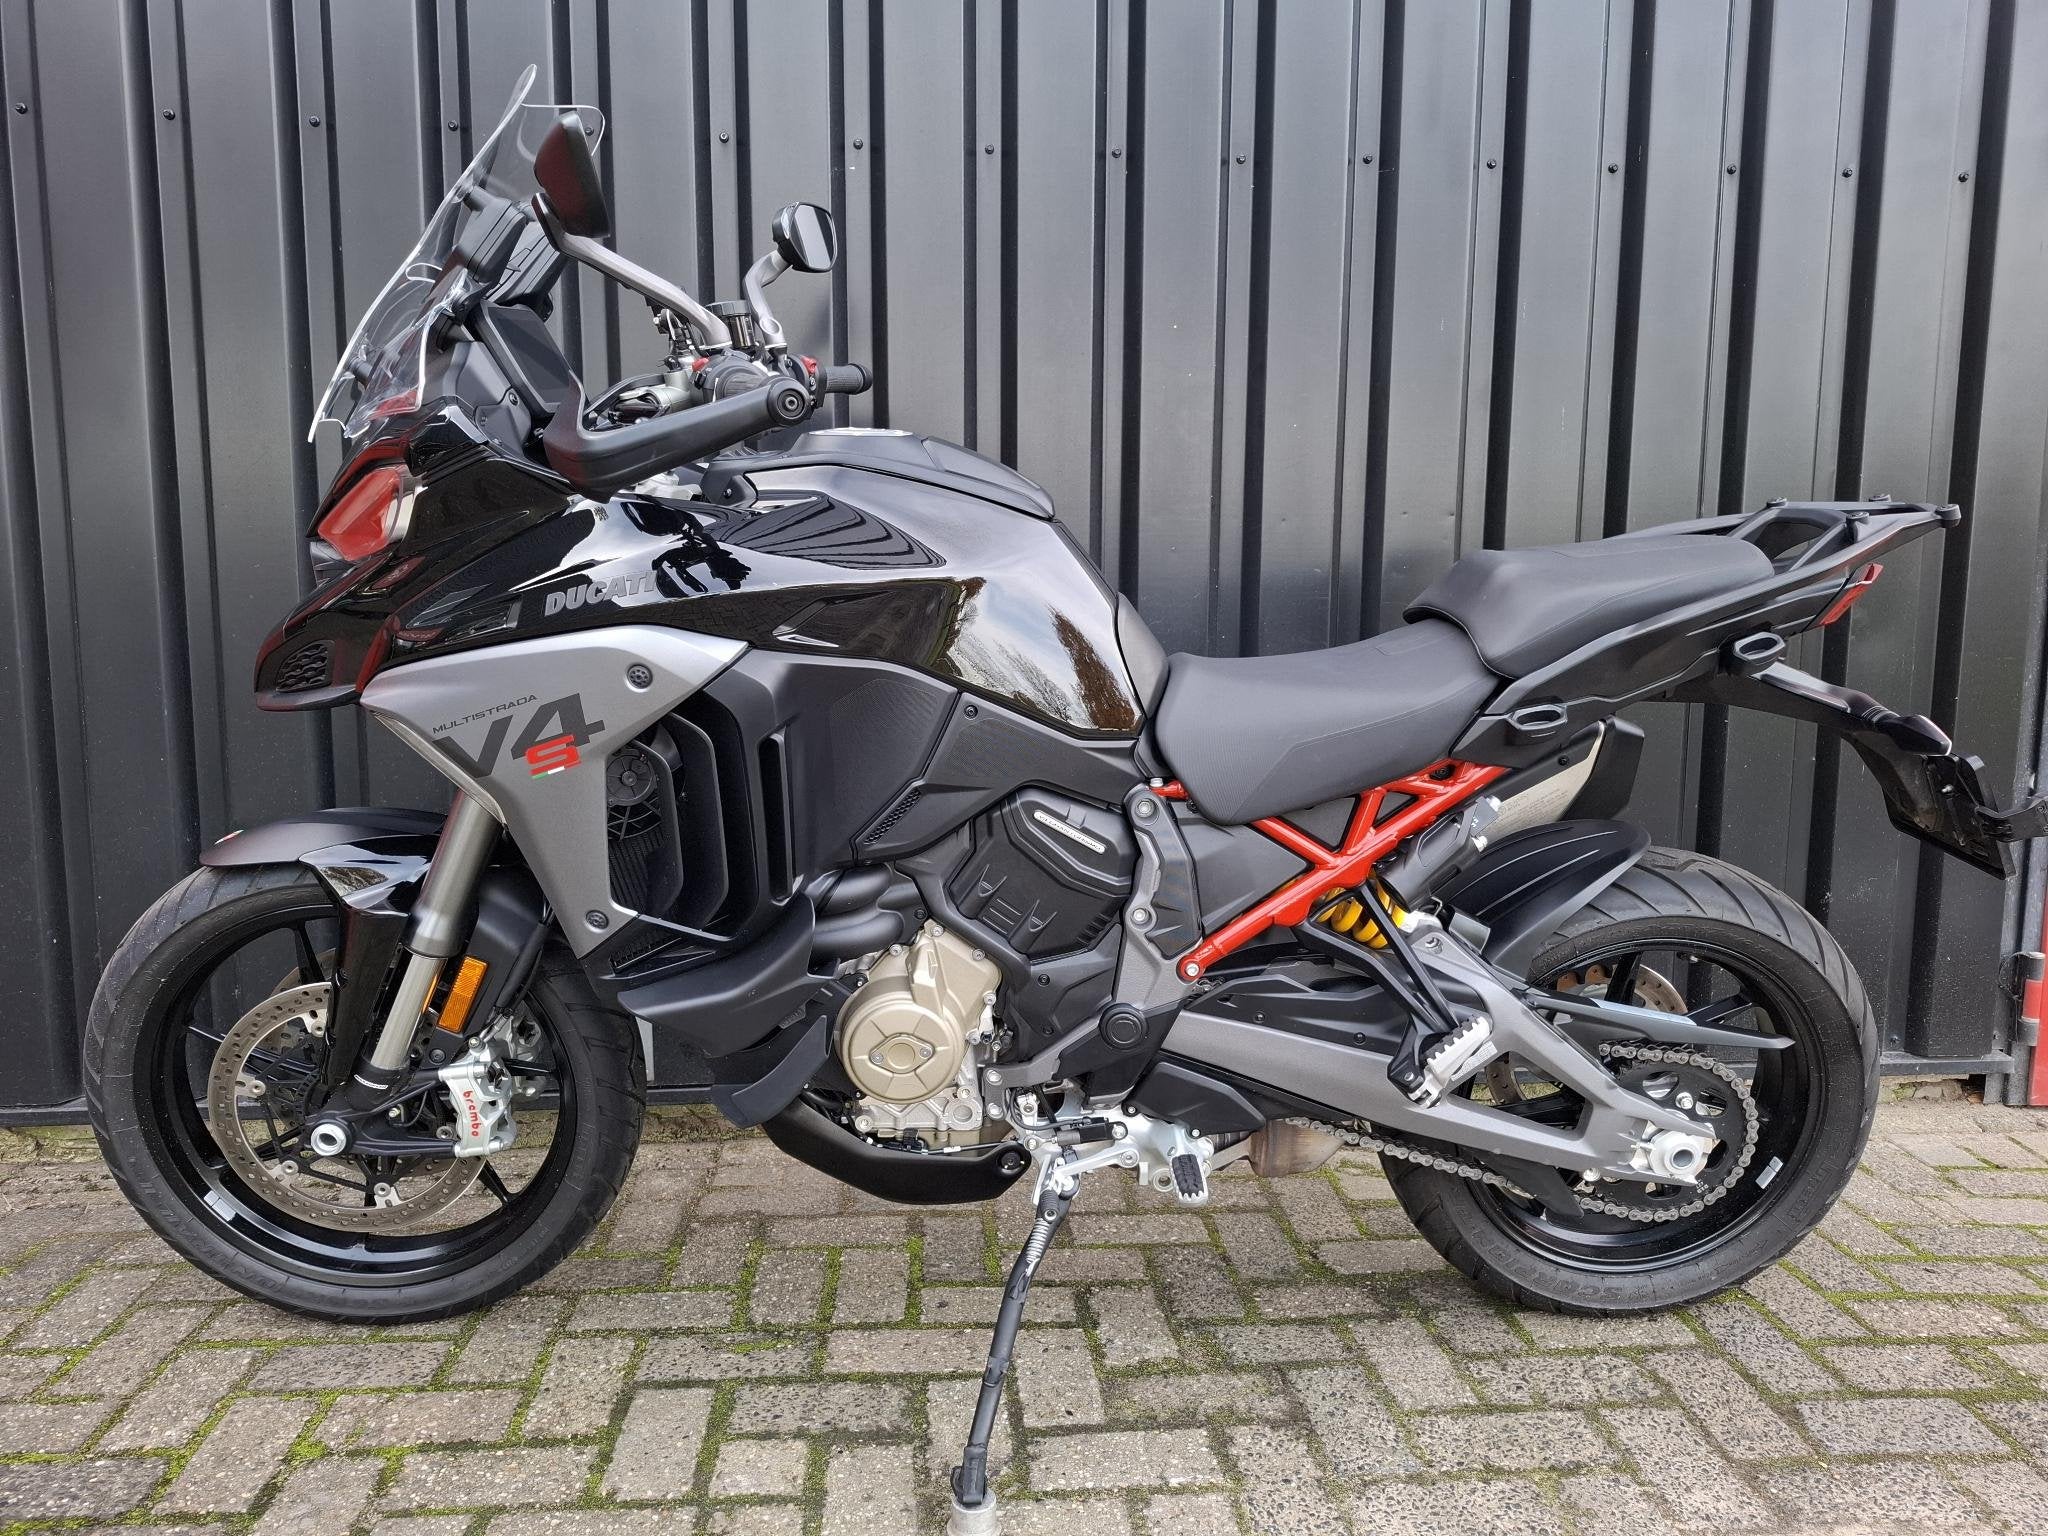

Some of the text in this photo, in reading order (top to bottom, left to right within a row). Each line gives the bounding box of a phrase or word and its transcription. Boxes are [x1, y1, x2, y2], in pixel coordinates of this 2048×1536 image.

[544, 570, 658, 617] DUCATI
[432, 694, 538, 734] MULTISTRADA
[432, 692, 606, 779] V4
[525, 734, 582, 776] S
[462, 1090, 481, 1138] brembo
